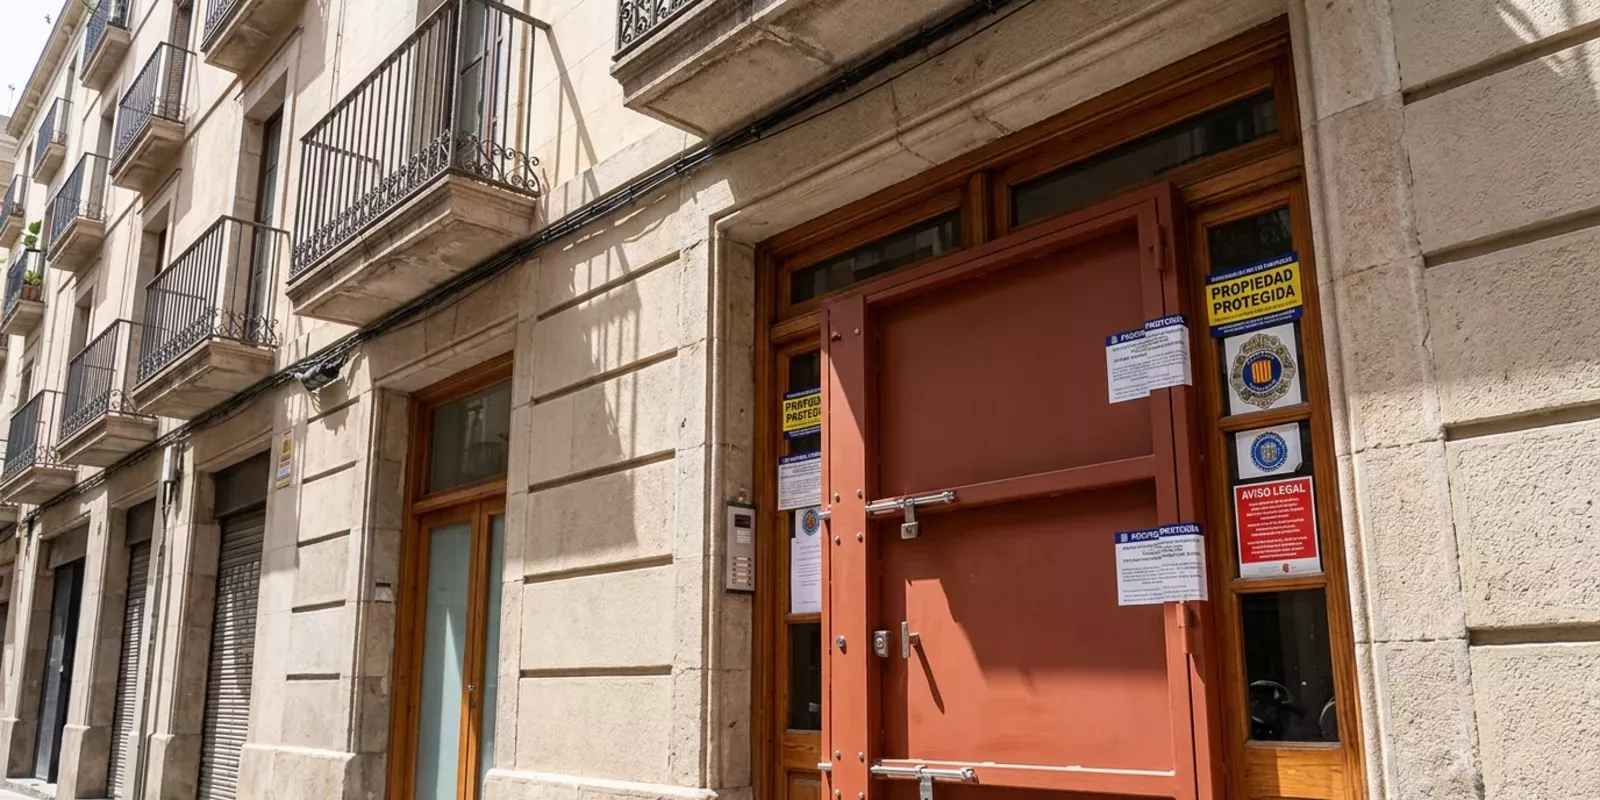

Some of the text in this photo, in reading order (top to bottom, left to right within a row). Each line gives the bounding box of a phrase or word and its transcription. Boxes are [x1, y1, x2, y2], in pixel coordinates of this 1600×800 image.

[1211, 268, 1293, 300] PROPIEDAD
[1213, 285, 1295, 315] PROTEGIDA
[1241, 483, 1306, 500] AVISO LEGAL
